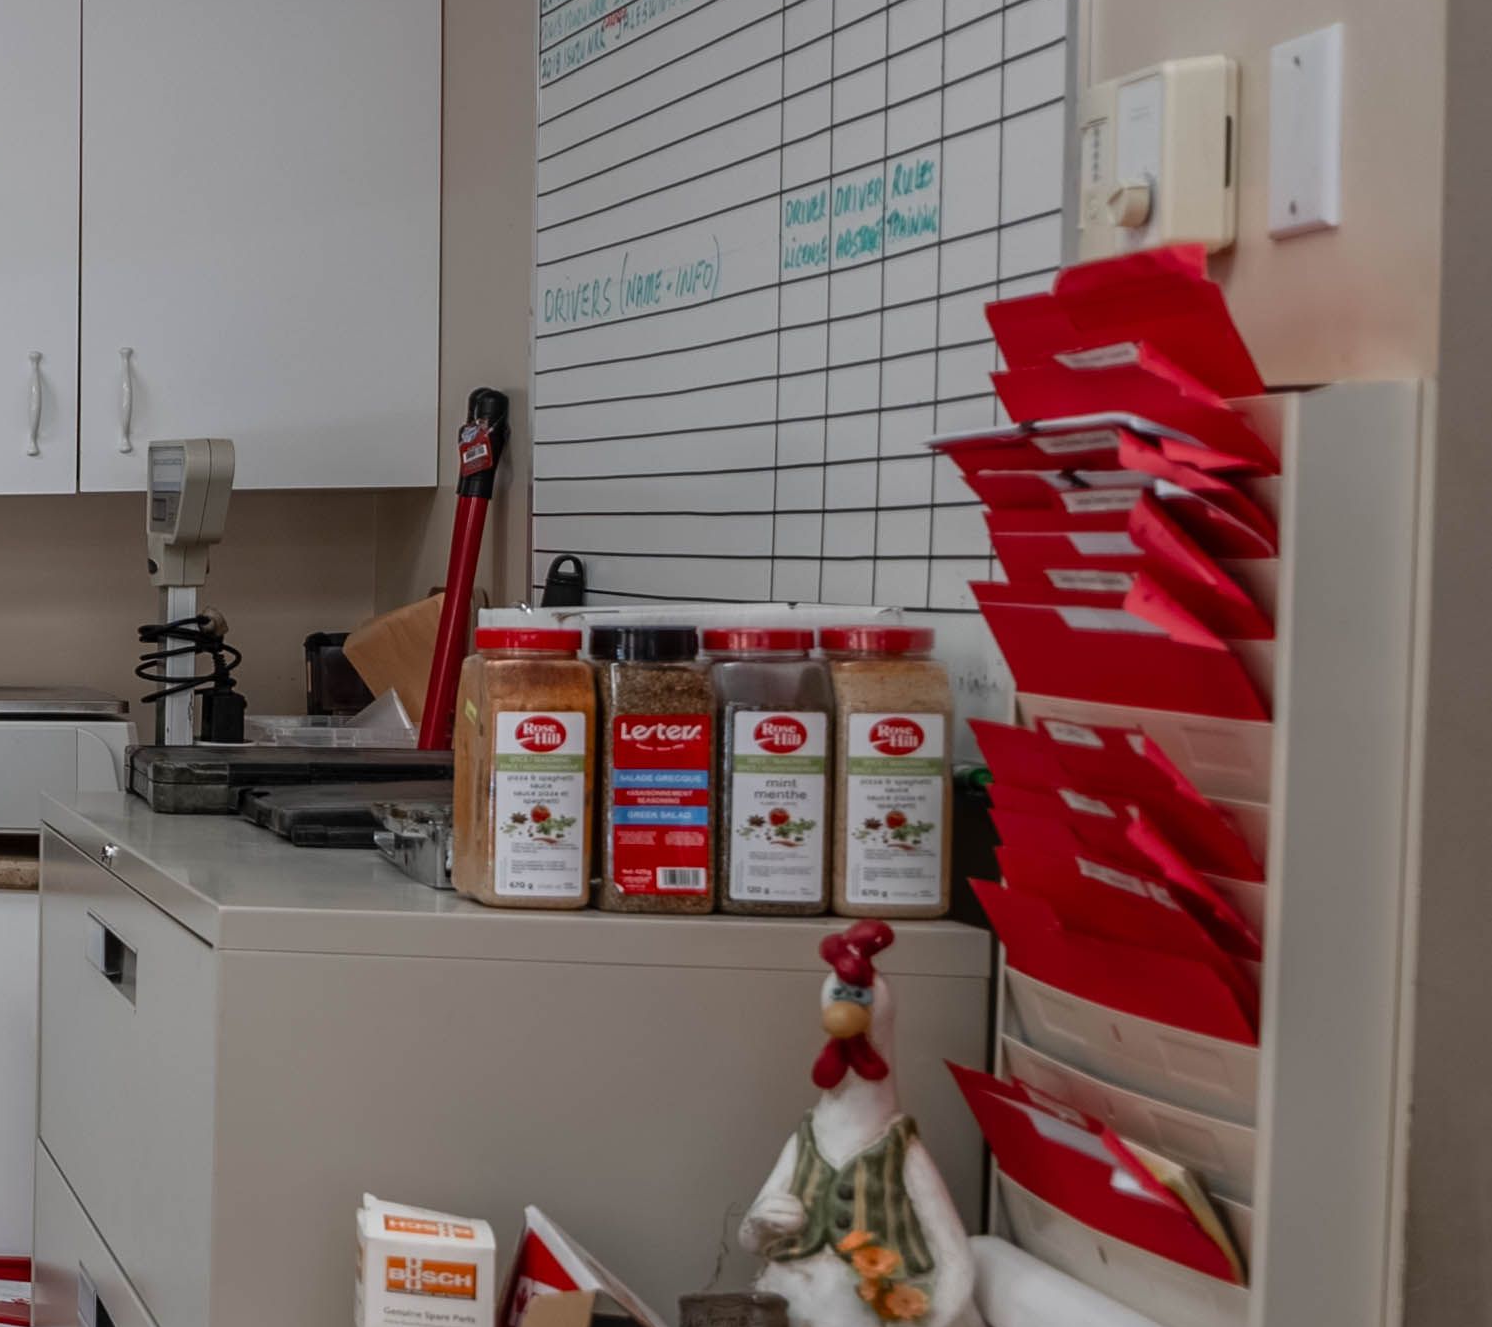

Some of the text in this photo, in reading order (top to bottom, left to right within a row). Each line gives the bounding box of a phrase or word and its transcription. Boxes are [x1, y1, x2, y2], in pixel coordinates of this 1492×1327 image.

[834, 177, 883, 218] DRIVER
[784, 190, 827, 228] DRIVER
[543, 276, 613, 324] DRIVERS
[522, 722, 557, 736] Rose
[761, 722, 798, 736] Rose
[877, 724, 915, 738] Rose
[534, 731, 562, 746] Hill
[773, 732, 802, 746] Hill
[889, 734, 919, 748] Hill
[765, 778, 797, 787] mint
[754, 789, 807, 800] menthe
[388, 1258, 474, 1290] BUSCH
